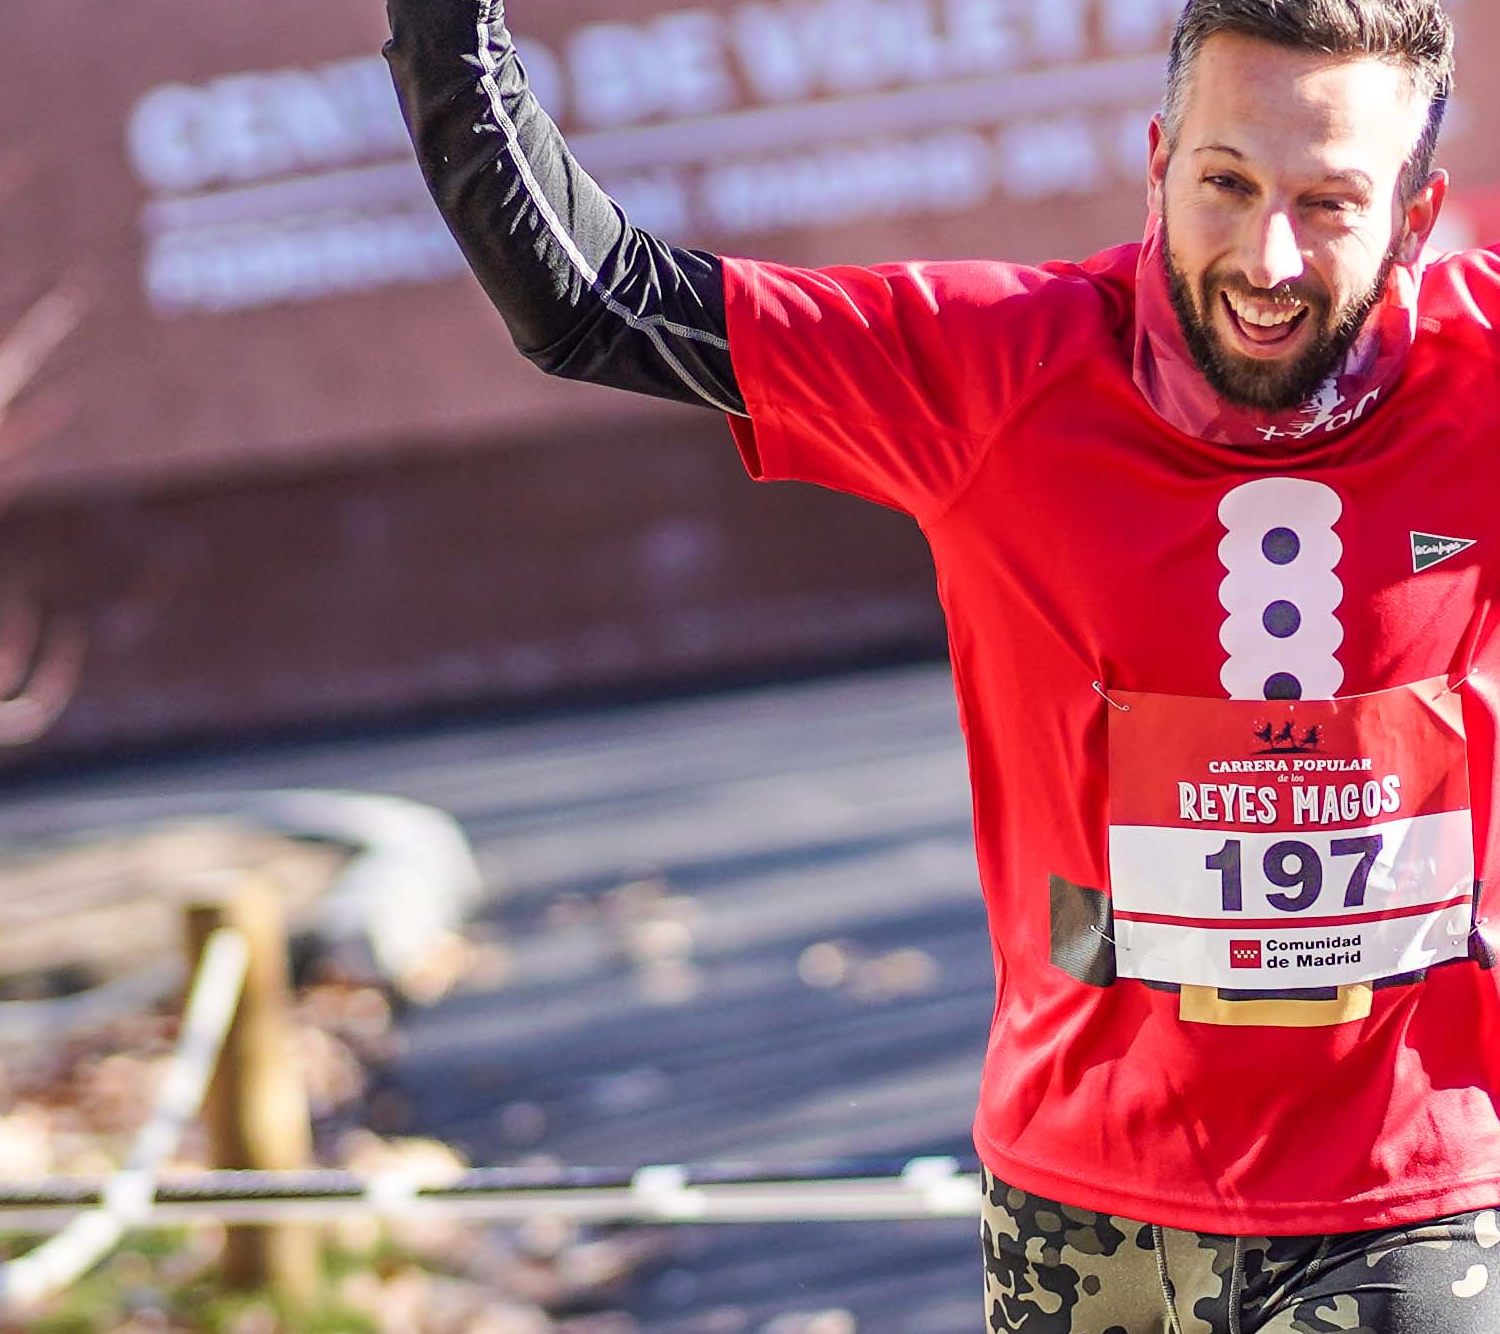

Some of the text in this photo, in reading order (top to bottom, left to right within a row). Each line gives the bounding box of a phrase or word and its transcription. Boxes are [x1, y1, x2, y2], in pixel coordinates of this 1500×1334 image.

[1209, 758, 1372, 773] CARRERA POPULAR
[1277, 773, 1305, 783] de los
[1178, 774, 1401, 825] REYES MAGOS
[1205, 834, 1383, 912] 197
[1266, 935, 1361, 952] Comunidad
[1266, 951, 1361, 968] de Madrid
